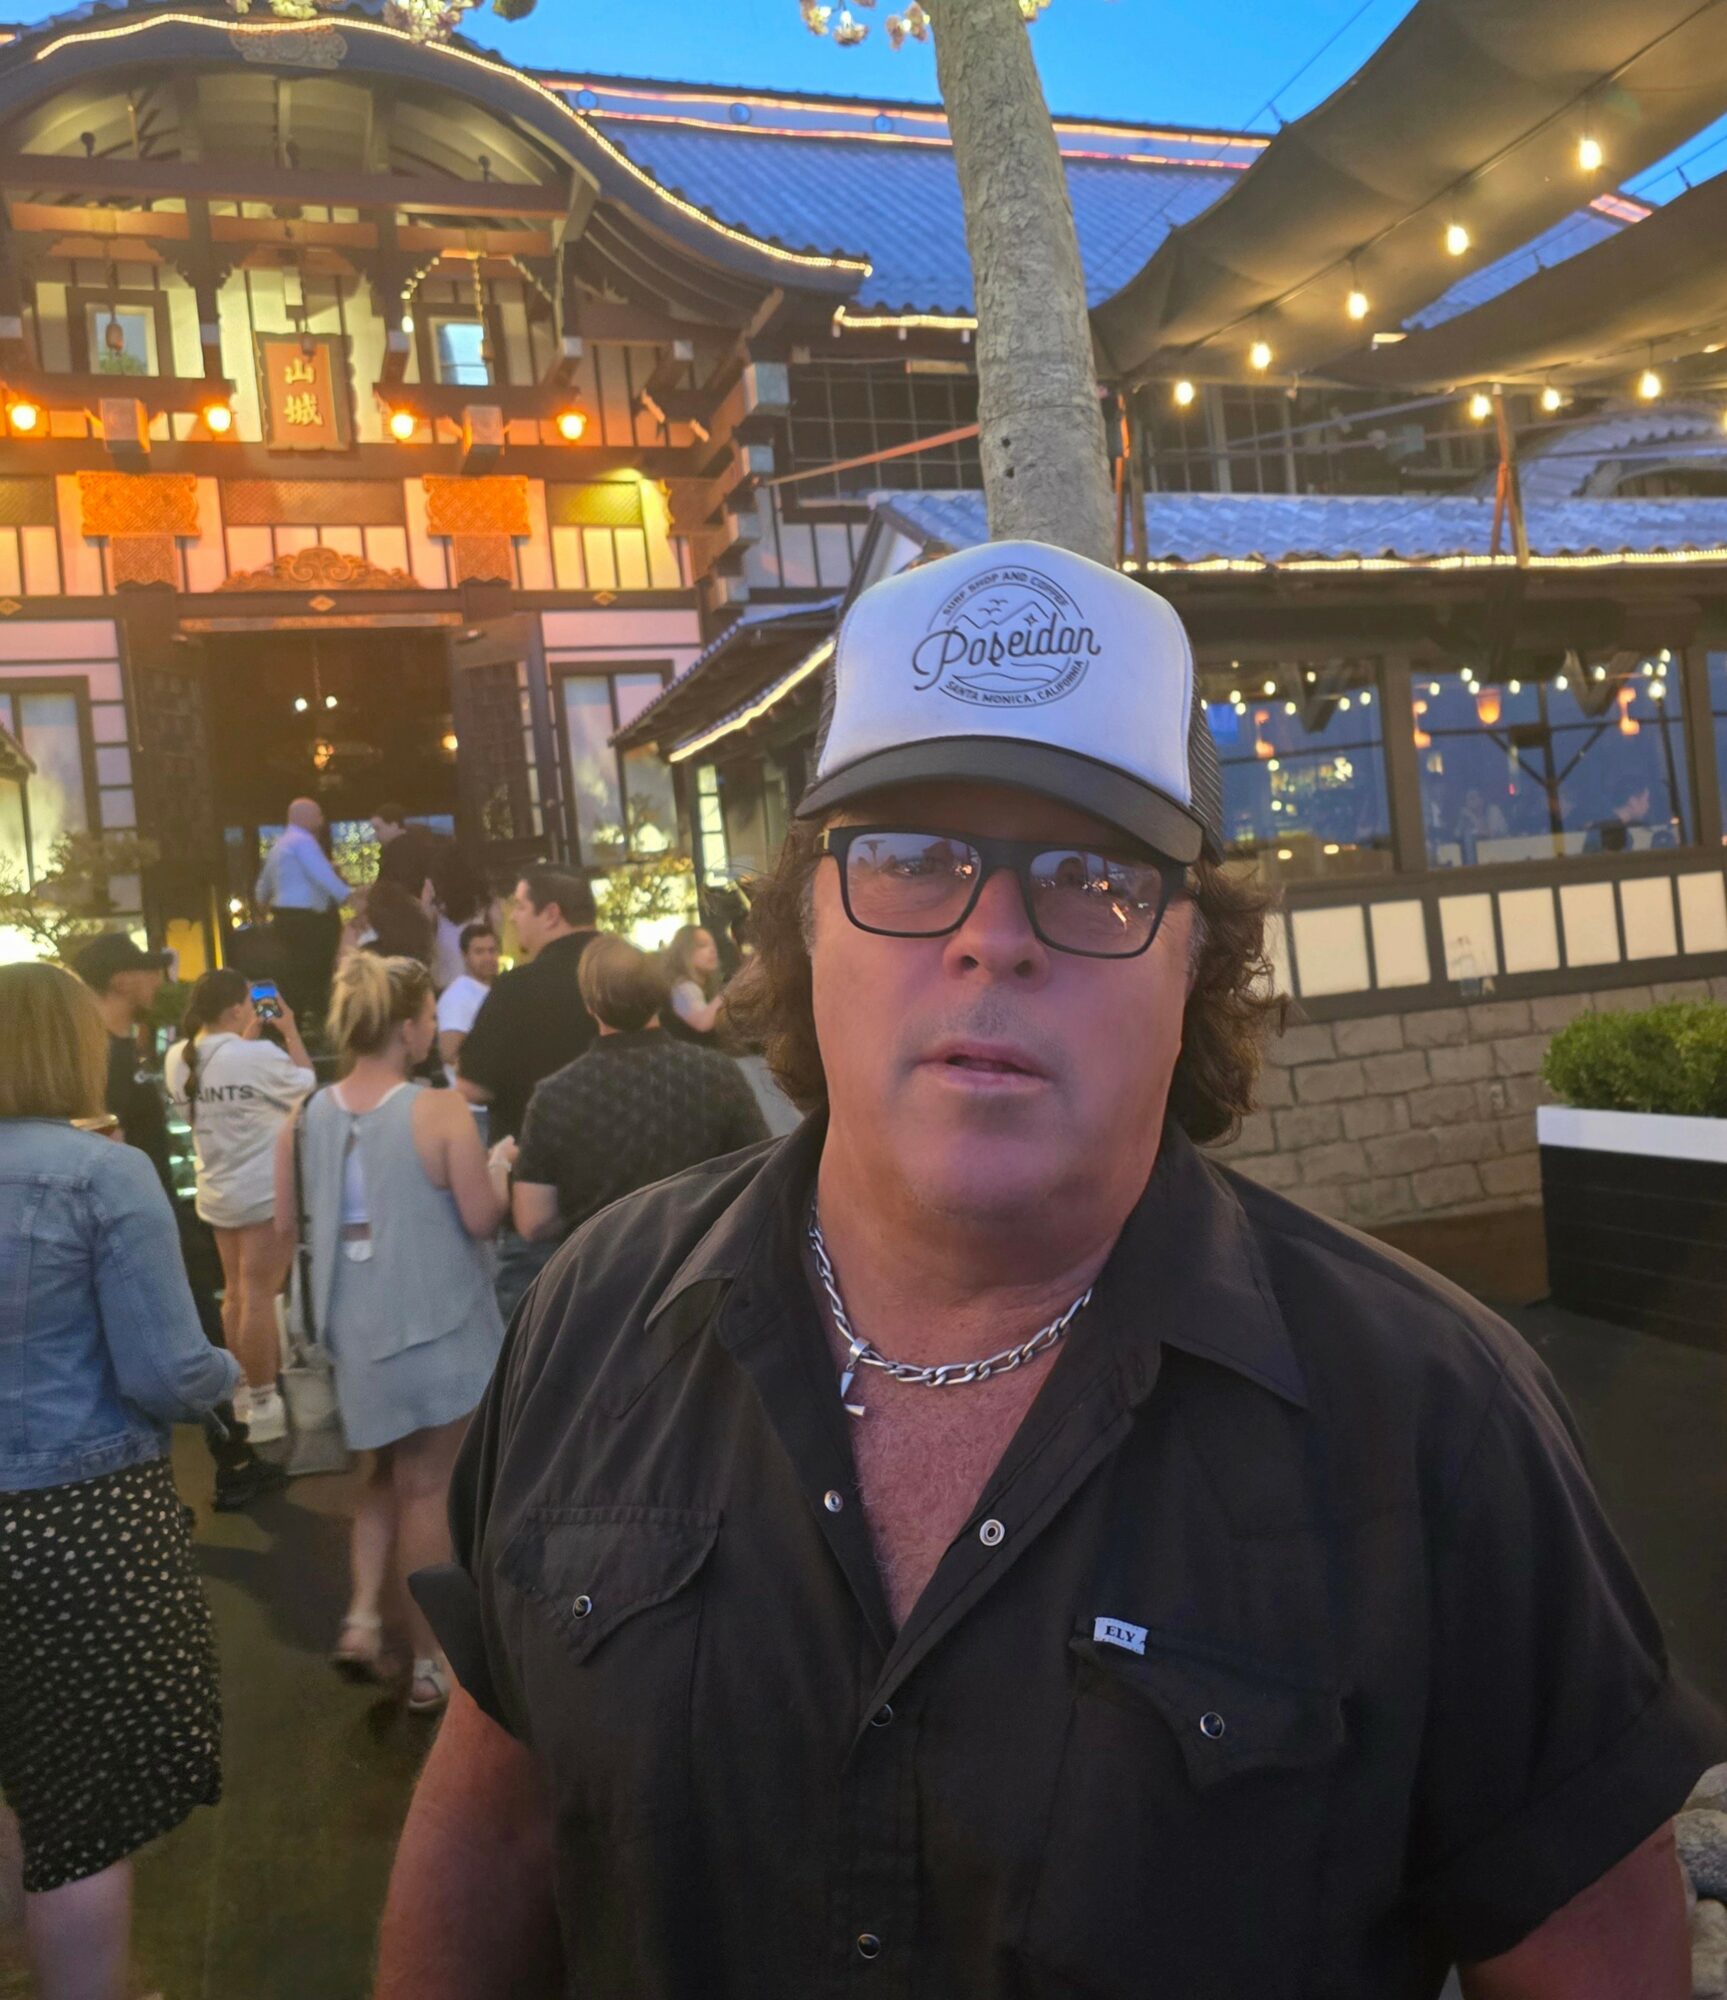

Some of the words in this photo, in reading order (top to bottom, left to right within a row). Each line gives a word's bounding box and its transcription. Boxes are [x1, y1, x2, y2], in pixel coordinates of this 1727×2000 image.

[284, 357, 323, 426] 山城
[943, 591, 966, 616] SURF
[968, 573, 999, 593] SHOP
[1002, 571, 1028, 583] AND
[912, 612, 1102, 691] Poseidon
[946, 681, 978, 700] SANTA
[982, 694, 1037, 704] MONICA,
[1038, 660, 1084, 700] CALIFORNIA
[1105, 1625, 1136, 1643] ELY
